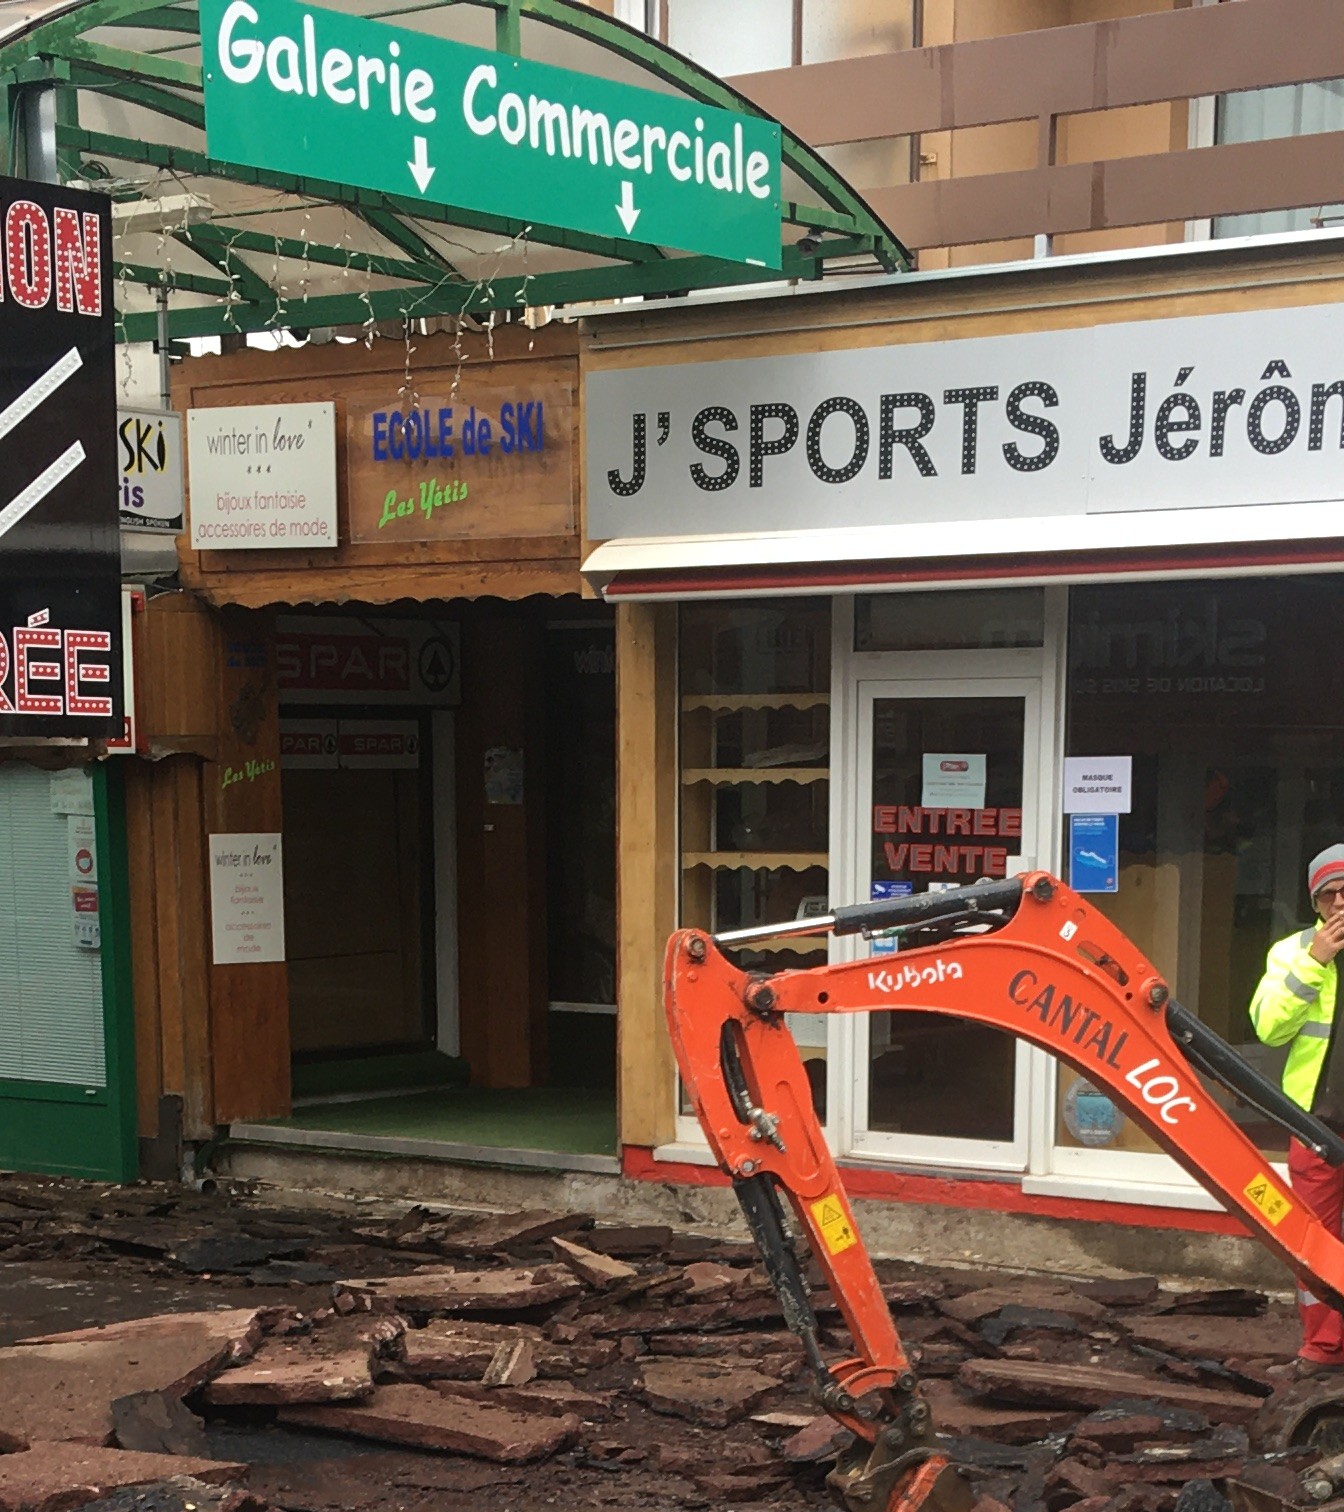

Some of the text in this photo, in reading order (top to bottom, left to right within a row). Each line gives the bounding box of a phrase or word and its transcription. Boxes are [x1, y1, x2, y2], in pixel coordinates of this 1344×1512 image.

[217, 1, 771, 199] Galerie Commerciale
[207, 427, 252, 455] winter
[255, 425, 268, 454] in
[373, 401, 544, 462] ECOLE de SKI
[117, 477, 144, 508] is
[216, 490, 307, 515] bijoux fantaisie
[378, 477, 469, 528] Les Yétis
[197, 517, 329, 538] accessoires de mode
[275, 643, 407, 680] SPAR
[354, 737, 402, 751] SPAR
[872, 805, 1022, 836] ENTREE
[884, 842, 1007, 875] VENTE
[867, 959, 963, 993] Kubota
[1008, 969, 1197, 1124] CANTAL LOC
